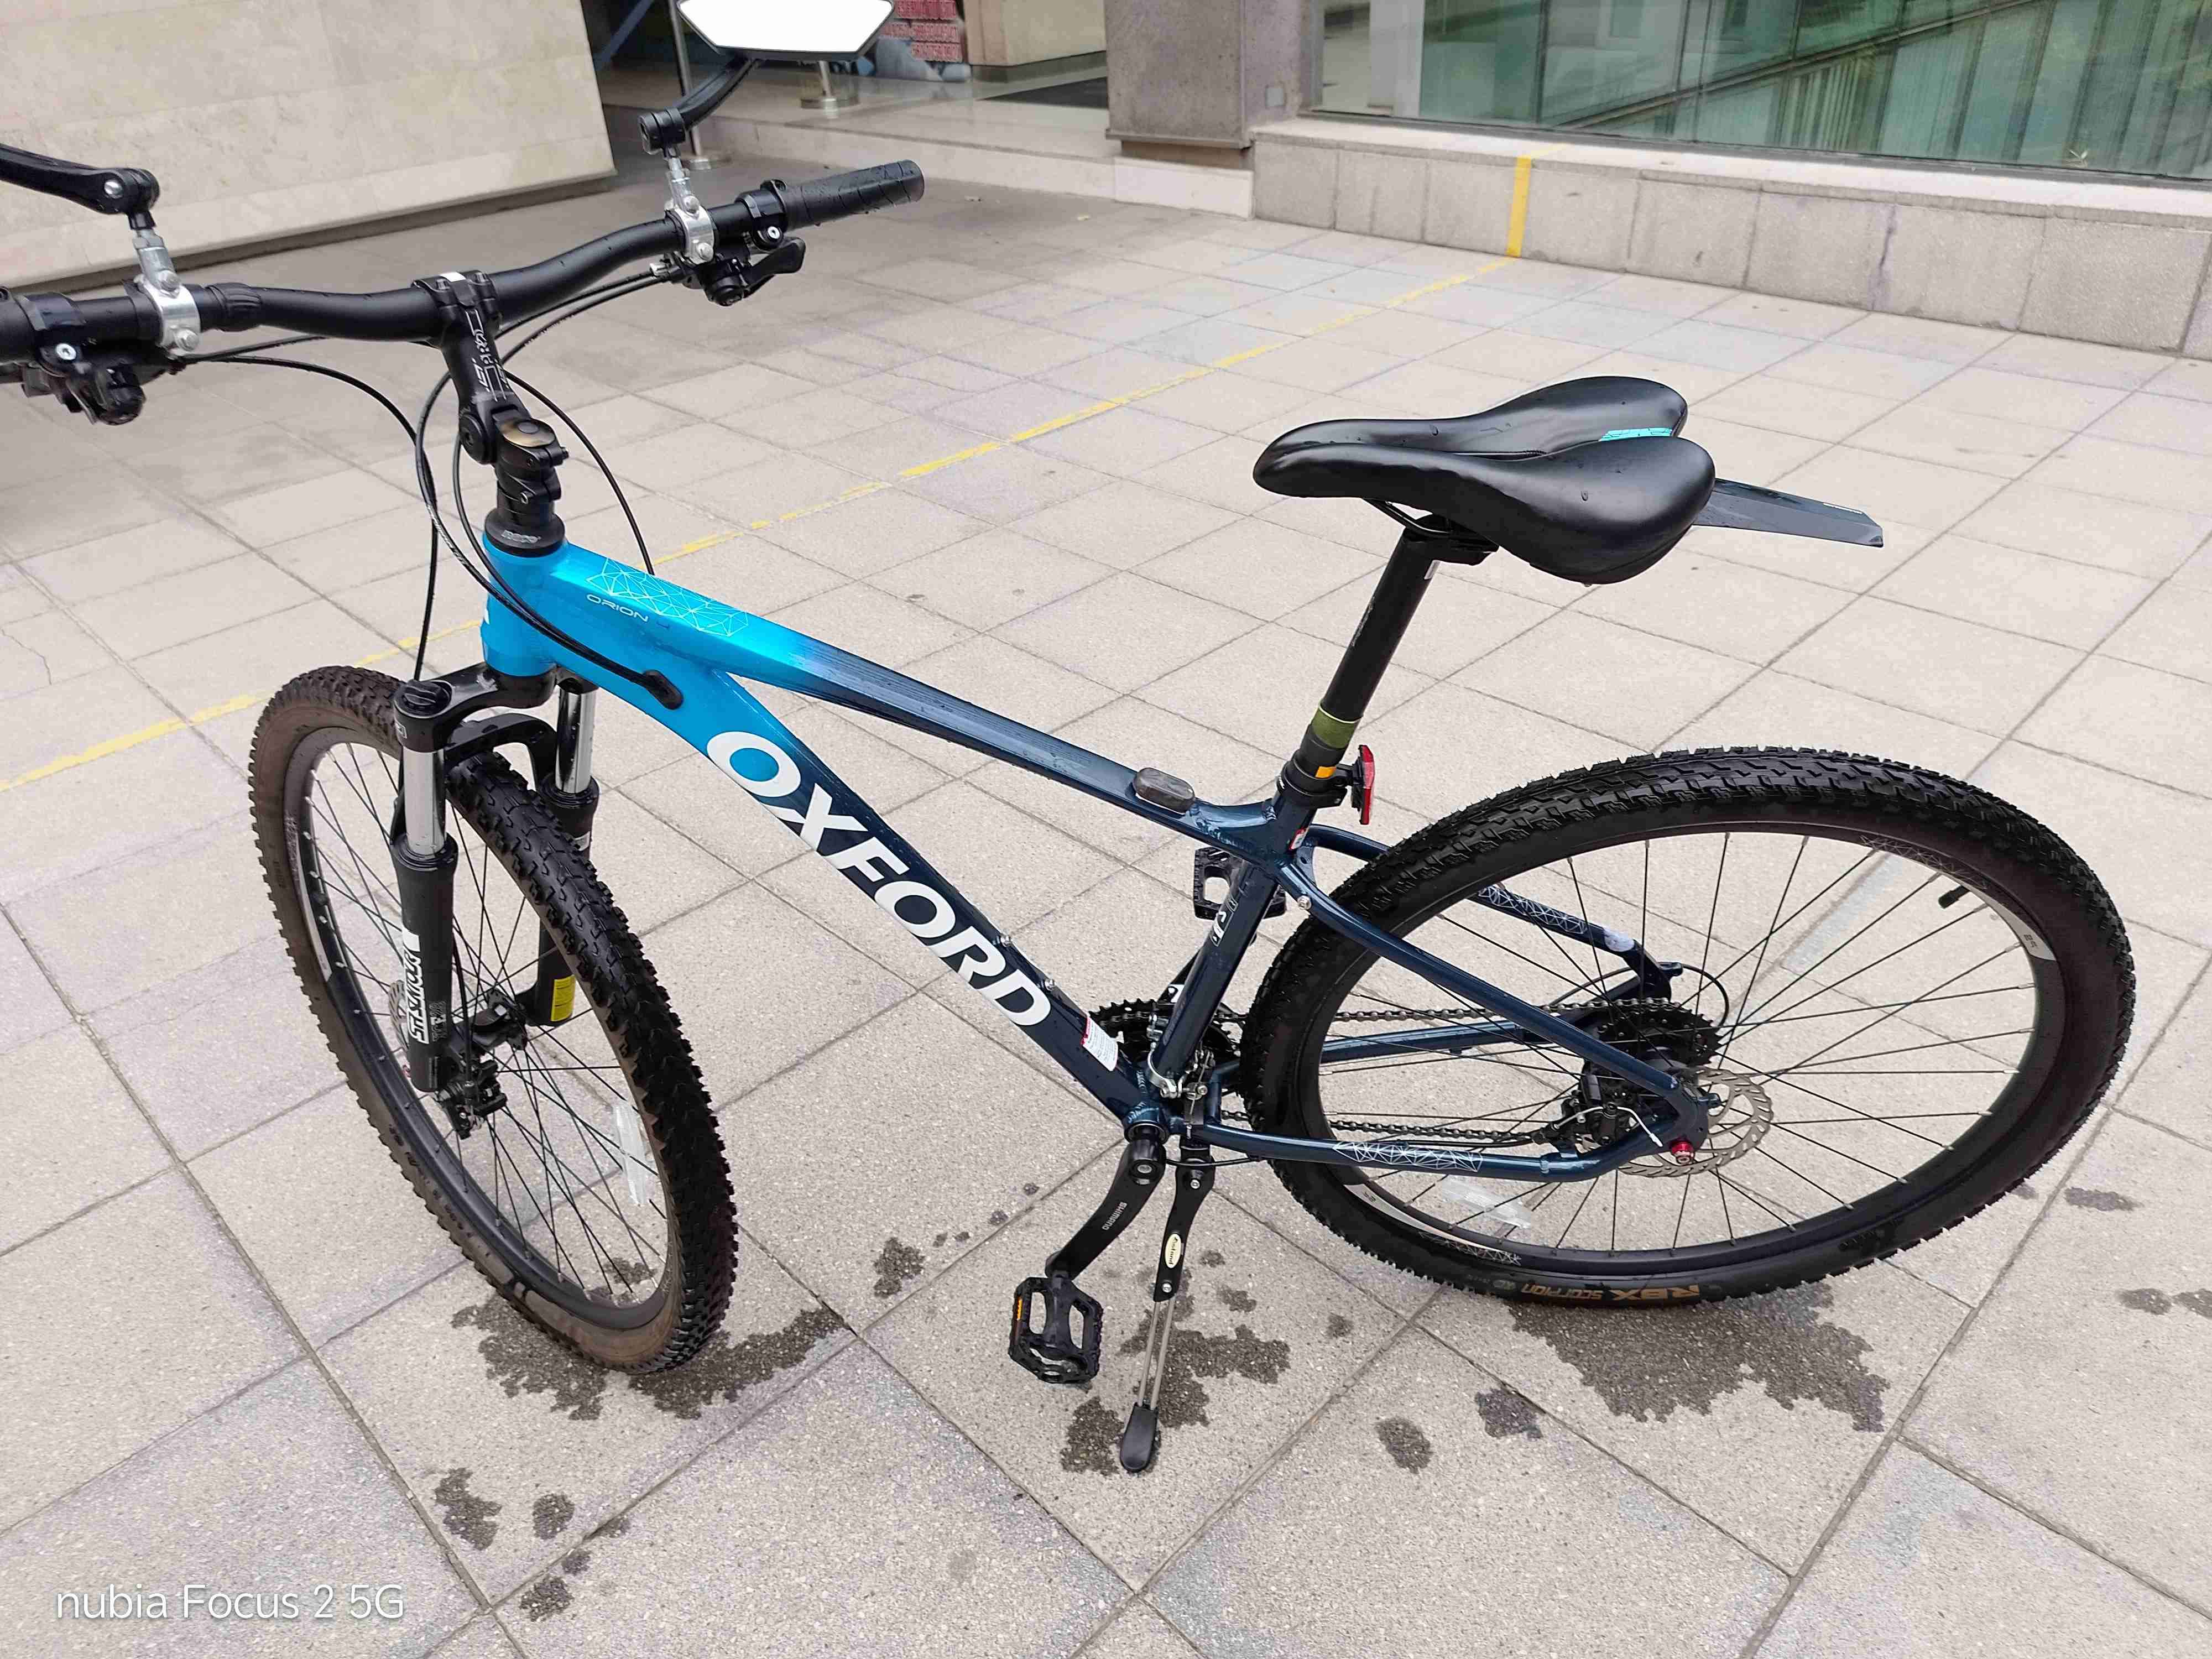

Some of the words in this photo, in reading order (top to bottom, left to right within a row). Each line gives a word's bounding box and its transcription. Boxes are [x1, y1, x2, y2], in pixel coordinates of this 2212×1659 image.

[587, 594, 649, 623] ORION
[707, 731, 1051, 1026] OXFORD
[1521, 1283, 1604, 1300] SCORPION
[1607, 1284, 1700, 1301] RBX
